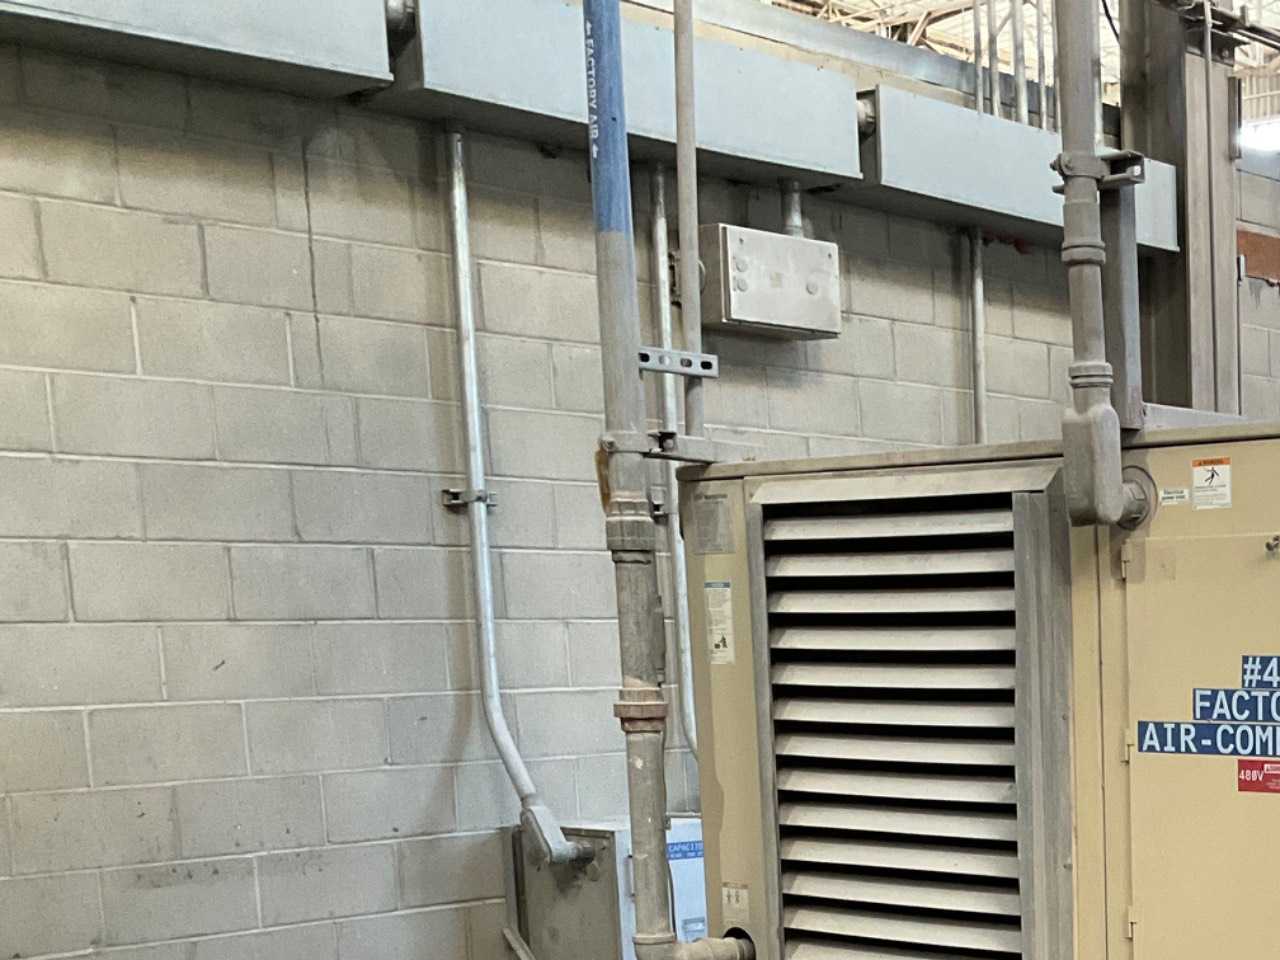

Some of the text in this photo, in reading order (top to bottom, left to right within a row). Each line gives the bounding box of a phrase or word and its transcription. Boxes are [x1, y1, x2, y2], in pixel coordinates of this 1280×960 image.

[586, 38, 599, 139] FACTORY AIR
[1243, 657, 1280, 688] #4
[1239, 769, 1265, 782] 480V
